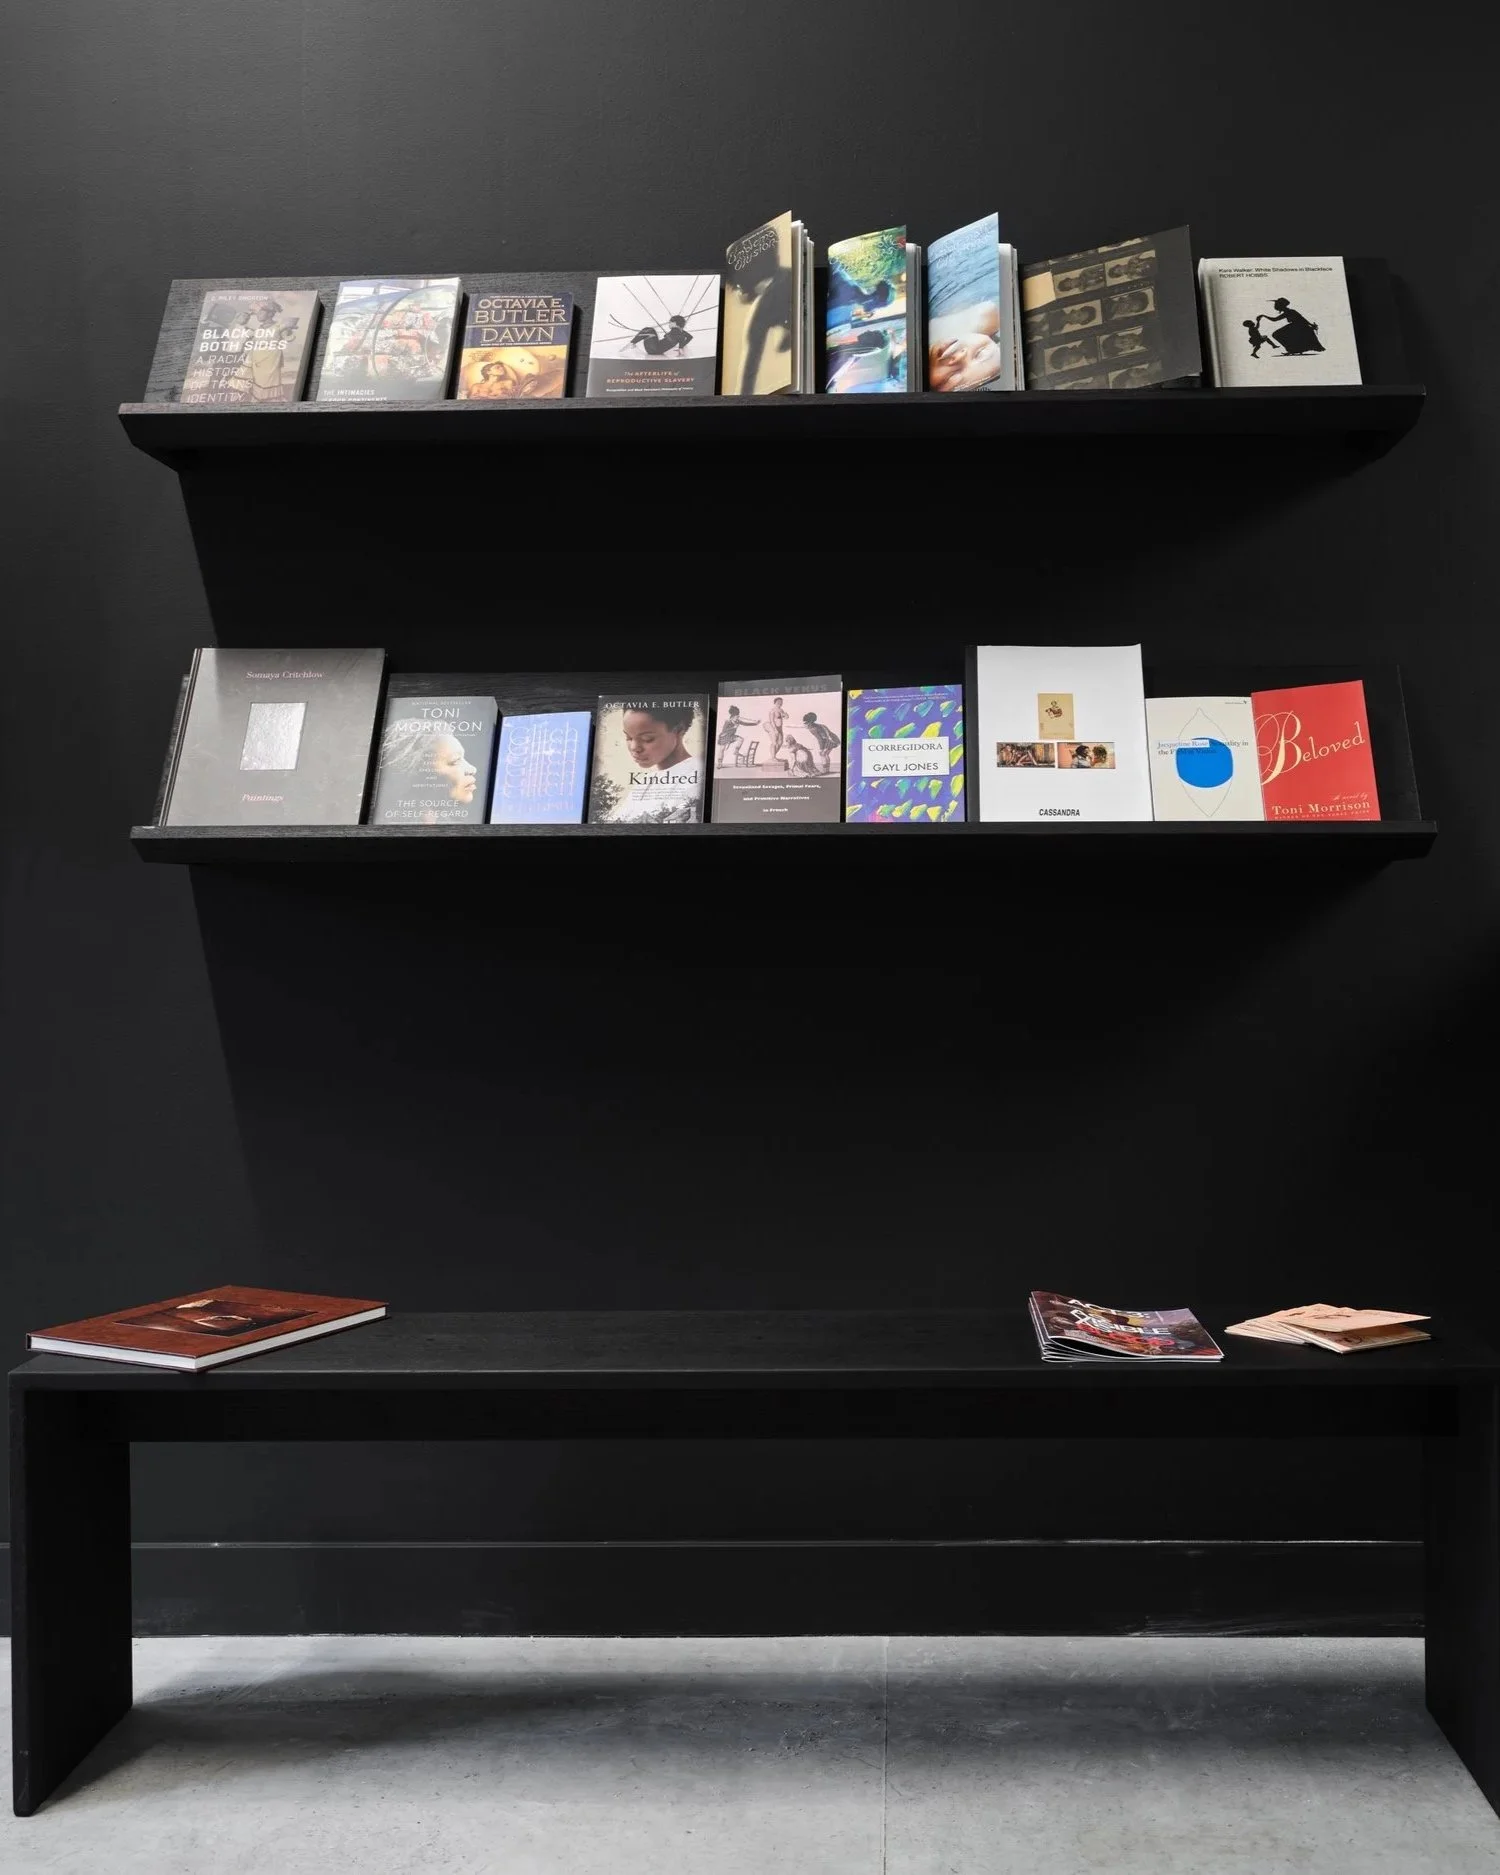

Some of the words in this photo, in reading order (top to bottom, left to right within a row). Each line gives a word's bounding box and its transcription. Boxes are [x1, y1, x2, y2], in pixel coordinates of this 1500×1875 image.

[477, 298, 549, 309] OCTAVIA
[550, 298, 566, 308] E.
[474, 308, 567, 324] BUTLER
[202, 328, 250, 340] BLACK
[254, 328, 276, 339] ON
[481, 326, 557, 343] DAWN
[199, 341, 240, 352] BOTH
[244, 339, 289, 351] SIDES
[194, 355, 204, 365] A
[207, 353, 252, 364] RACIAL
[192, 366, 248, 378] HISTORY
[211, 379, 254, 389] TRANS
[186, 392, 247, 404] IDENTITY
[245, 671, 280, 681] Somaya
[282, 670, 323, 679] Critchlow
[734, 687, 781, 697] BLACK
[605, 701, 649, 709] OCTAVIA
[663, 700, 700, 709] BUTLER
[420, 707, 460, 719] TONI
[395, 720, 482, 732] MORRISON
[868, 742, 943, 752] CORREGIDORA
[1157, 740, 1191, 750] Jacqueline
[1255, 710, 1366, 786] Beloved
[1157, 748, 1169, 756] the
[872, 762, 901, 772] GAYL
[903, 761, 940, 772] JONES
[629, 770, 699, 785] Kindred
[241, 793, 284, 802] Paintings
[397, 799, 417, 808] THE
[419, 799, 460, 808] SOURCE
[1271, 804, 1304, 815] Toni
[1308, 801, 1371, 814] Morrison
[384, 810, 400, 818] OF
[401, 809, 469, 818] SELF-REGARD
[1039, 808, 1081, 817] CASSANDRA
